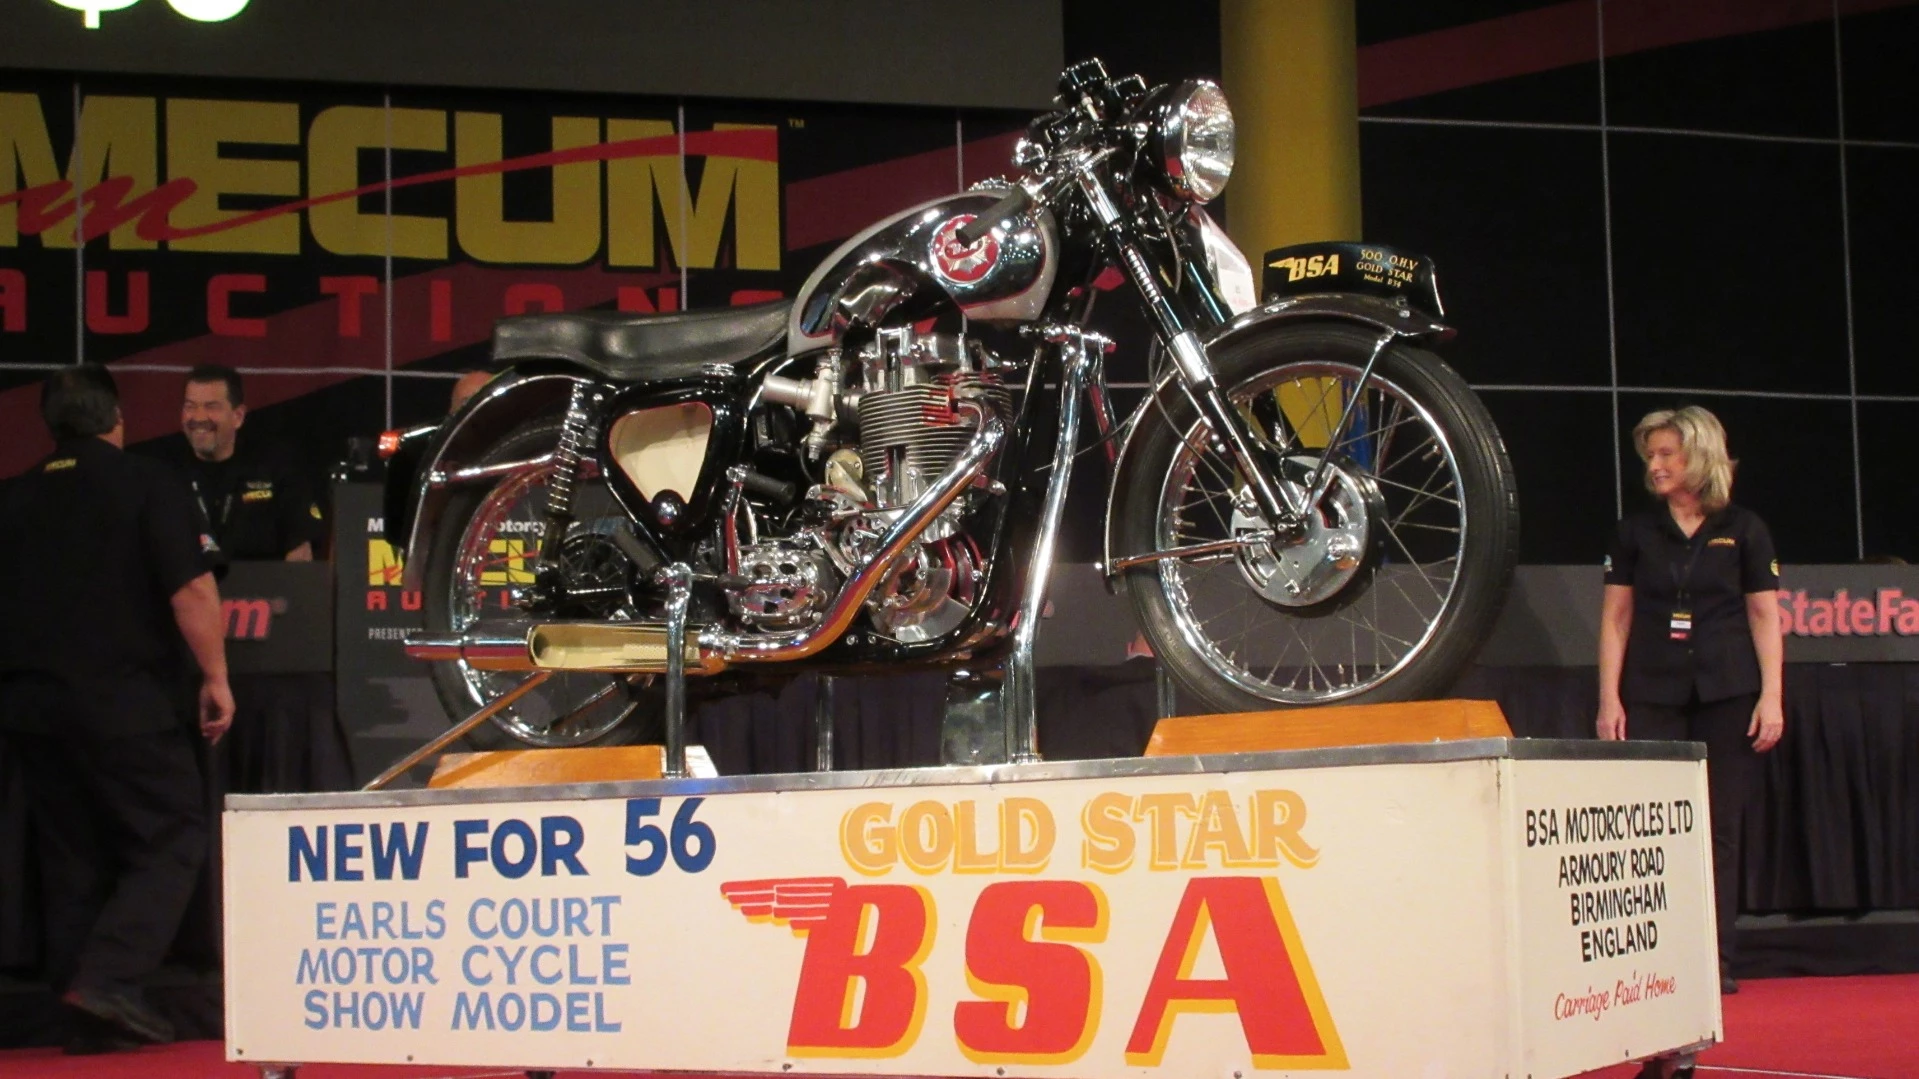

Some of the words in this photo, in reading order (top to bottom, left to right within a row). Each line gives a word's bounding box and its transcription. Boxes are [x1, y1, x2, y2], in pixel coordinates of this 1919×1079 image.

[0, 91, 780, 271] MECUM
[1287, 254, 1340, 282] BSA
[1356, 261, 1383, 273] GOLD
[1388, 268, 1413, 283] STAR
[1360, 249, 1383, 262] 500
[0, 269, 783, 343] UCTI
[368, 627, 423, 640] PRESEN
[288, 820, 430, 883] NEW
[453, 815, 590, 879] FOR
[623, 797, 717, 877] 56
[839, 797, 1057, 876] GOLD
[1080, 788, 1322, 873] STAR
[1526, 809, 1560, 848] BSA
[1565, 801, 1664, 844] MOTORCYCLES
[1668, 799, 1694, 835] LTD
[1559, 850, 1627, 888] ARMOURY
[1631, 846, 1665, 879] ROAD
[316, 900, 447, 940] EARLS
[467, 895, 622, 939] COURT
[1570, 881, 1667, 926] BIRMINGHAM
[1581, 920, 1658, 962] ENGLAND
[296, 946, 439, 986] MOTOR
[461, 943, 631, 986] CYCLE
[784, 875, 1351, 1070] BSA
[303, 989, 425, 1031] SHOW
[450, 991, 622, 1033] MODEL
[1554, 985, 1611, 1021] Carriage
[1614, 970, 1643, 1007] Paid
[1645, 973, 1676, 1000] Home
